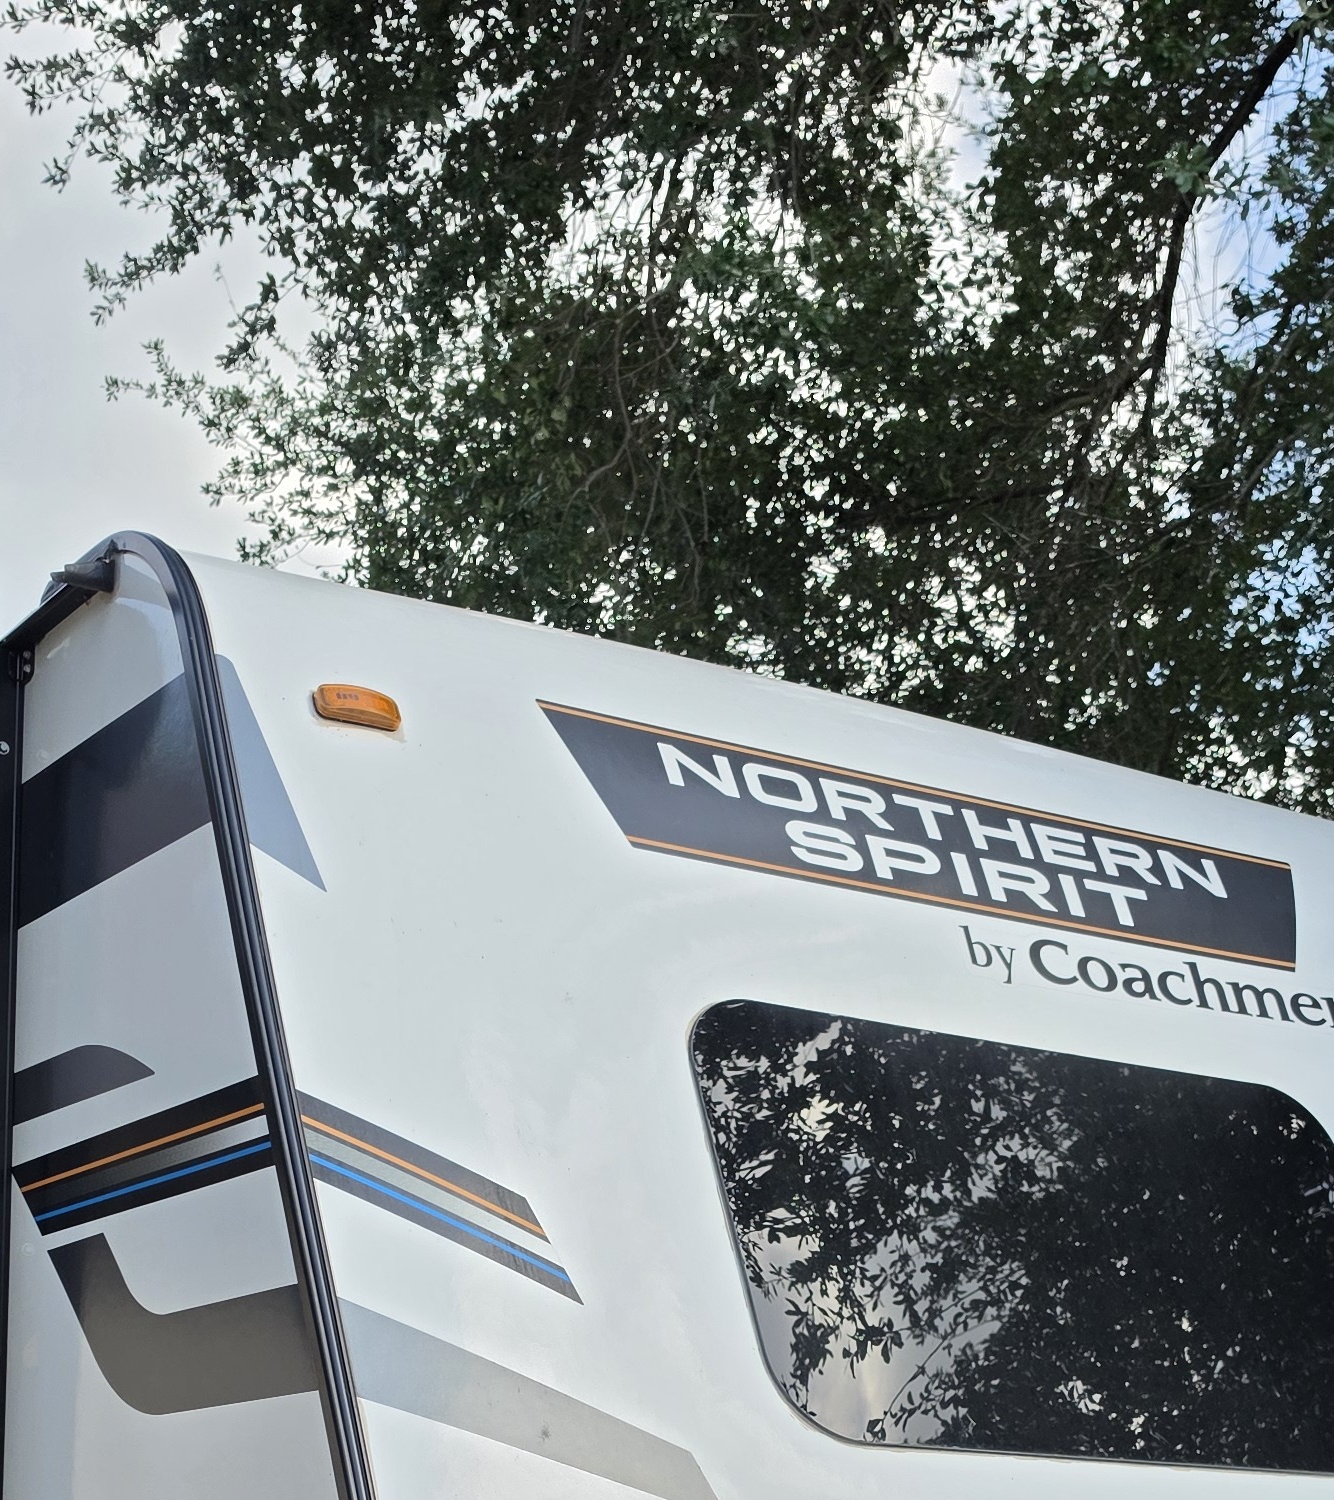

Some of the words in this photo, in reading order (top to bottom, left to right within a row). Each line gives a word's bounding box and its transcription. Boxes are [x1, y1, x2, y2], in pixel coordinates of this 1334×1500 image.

[656, 742, 1228, 900] NORTHERN
[785, 820, 1148, 928] SPIRIT
[958, 925, 1016, 984] by
